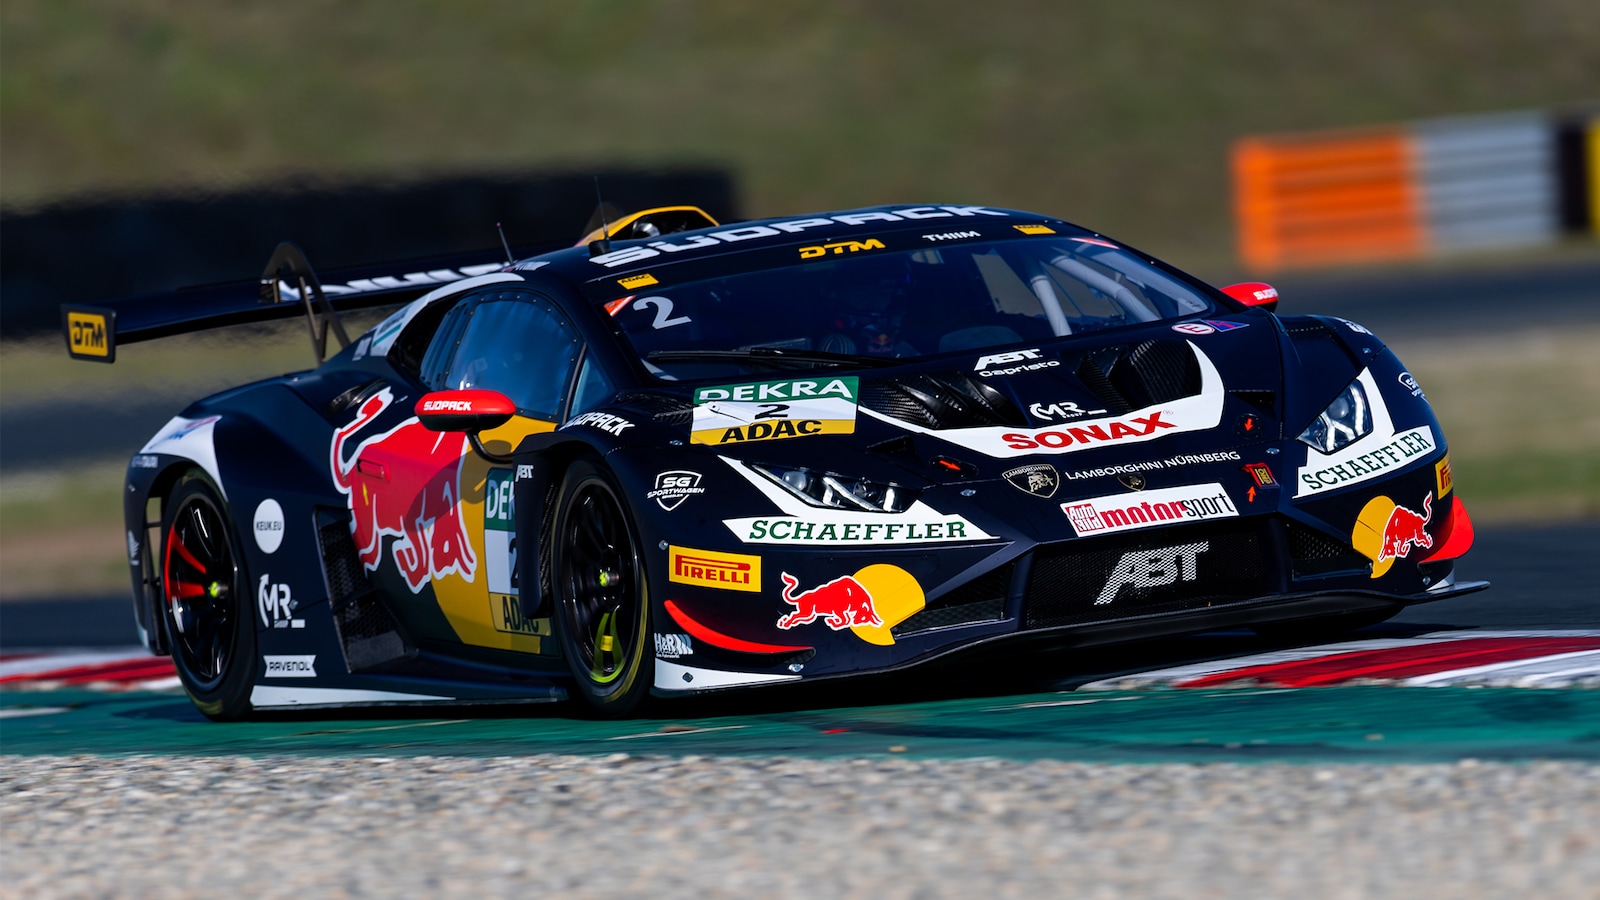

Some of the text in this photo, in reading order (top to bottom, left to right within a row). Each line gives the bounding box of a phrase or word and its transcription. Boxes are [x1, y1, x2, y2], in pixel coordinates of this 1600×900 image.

[922, 230, 982, 242] THIIM
[799, 238, 886, 259] DTM
[633, 296, 692, 330] 2
[73, 321, 104, 348] DTM
[974, 348, 1041, 371] ABT
[979, 361, 1060, 377] Capristo
[699, 379, 854, 401] DEKRA
[754, 404, 791, 420] 2
[720, 420, 823, 443] ADAC
[1002, 411, 1178, 450] SONAX
[1065, 451, 1241, 480] LAMBORGHINI NÜRNBERG
[1301, 431, 1431, 490] SCHAEFFLER
[515, 464, 534, 482] ABT
[662, 476, 692, 488] SG
[647, 488, 705, 499] SPORTWAGEN
[1068, 505, 1097, 520] Auto
[1100, 493, 1235, 528] motorsport
[749, 520, 967, 540] SCHAEFFLER
[1075, 516, 1104, 531] Bild
[675, 554, 751, 584] PIRELLI
[1094, 541, 1209, 605] ABT
[269, 661, 310, 671] RAVENOL
